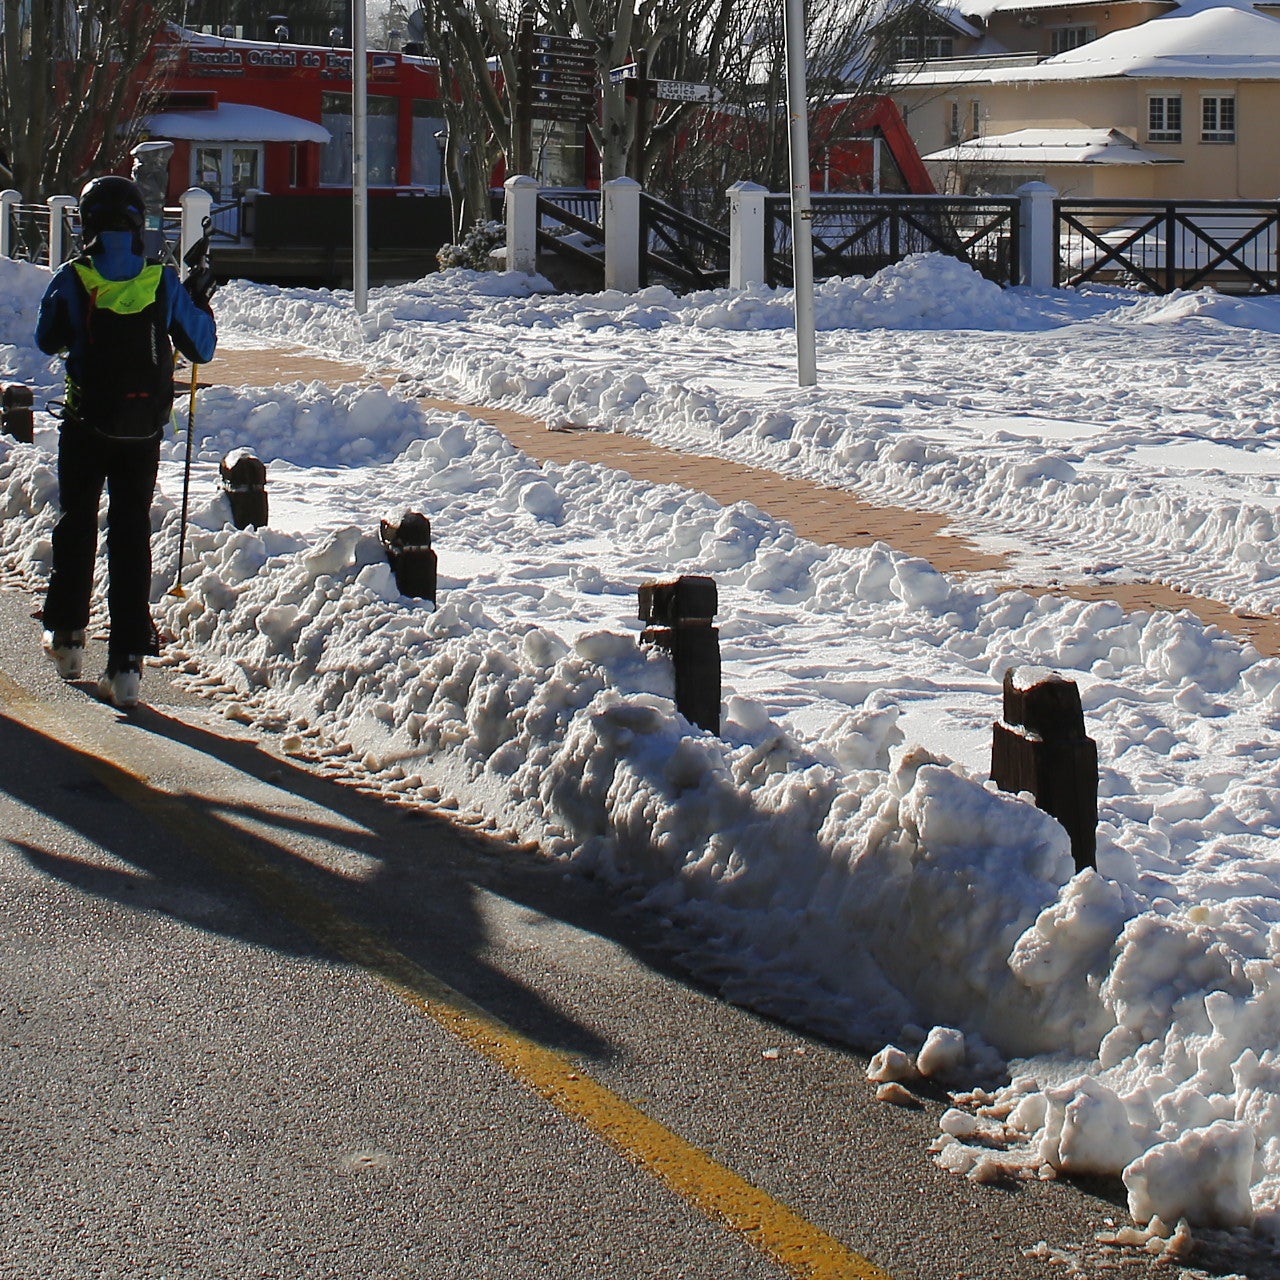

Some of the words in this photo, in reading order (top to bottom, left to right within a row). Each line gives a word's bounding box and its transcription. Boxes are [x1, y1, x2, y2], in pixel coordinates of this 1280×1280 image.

[188, 48, 242, 65] Escuela
[247, 49, 297, 67] Oficial
[301, 51, 321, 67] de
[325, 53, 353, 71] Esq
